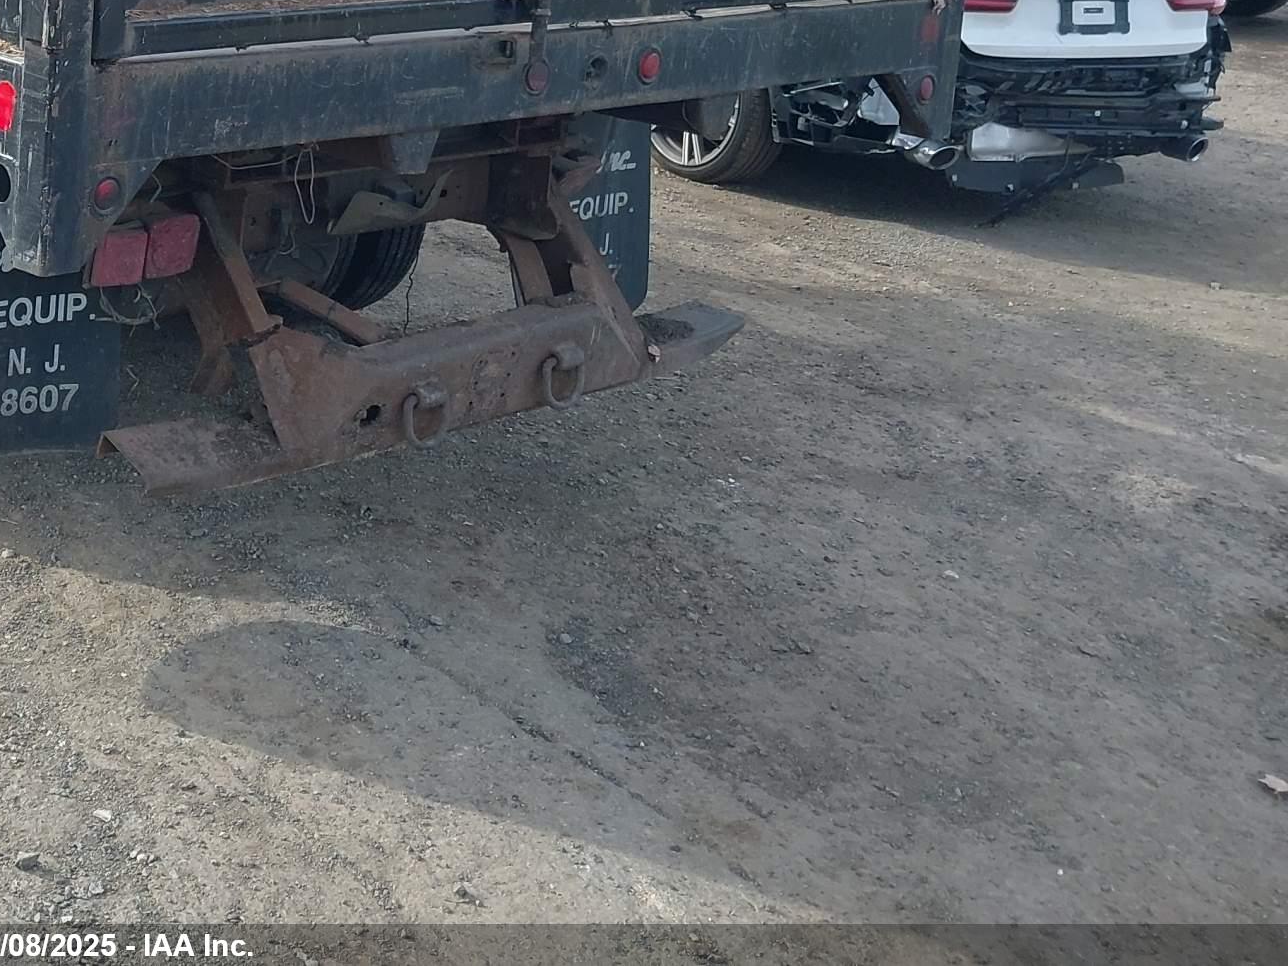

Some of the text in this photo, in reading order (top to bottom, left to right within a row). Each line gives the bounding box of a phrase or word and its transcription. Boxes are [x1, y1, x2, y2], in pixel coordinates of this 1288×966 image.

[599, 232, 613, 256] J.
[7, 346, 32, 377] N.
[44, 343, 66, 373] J.
